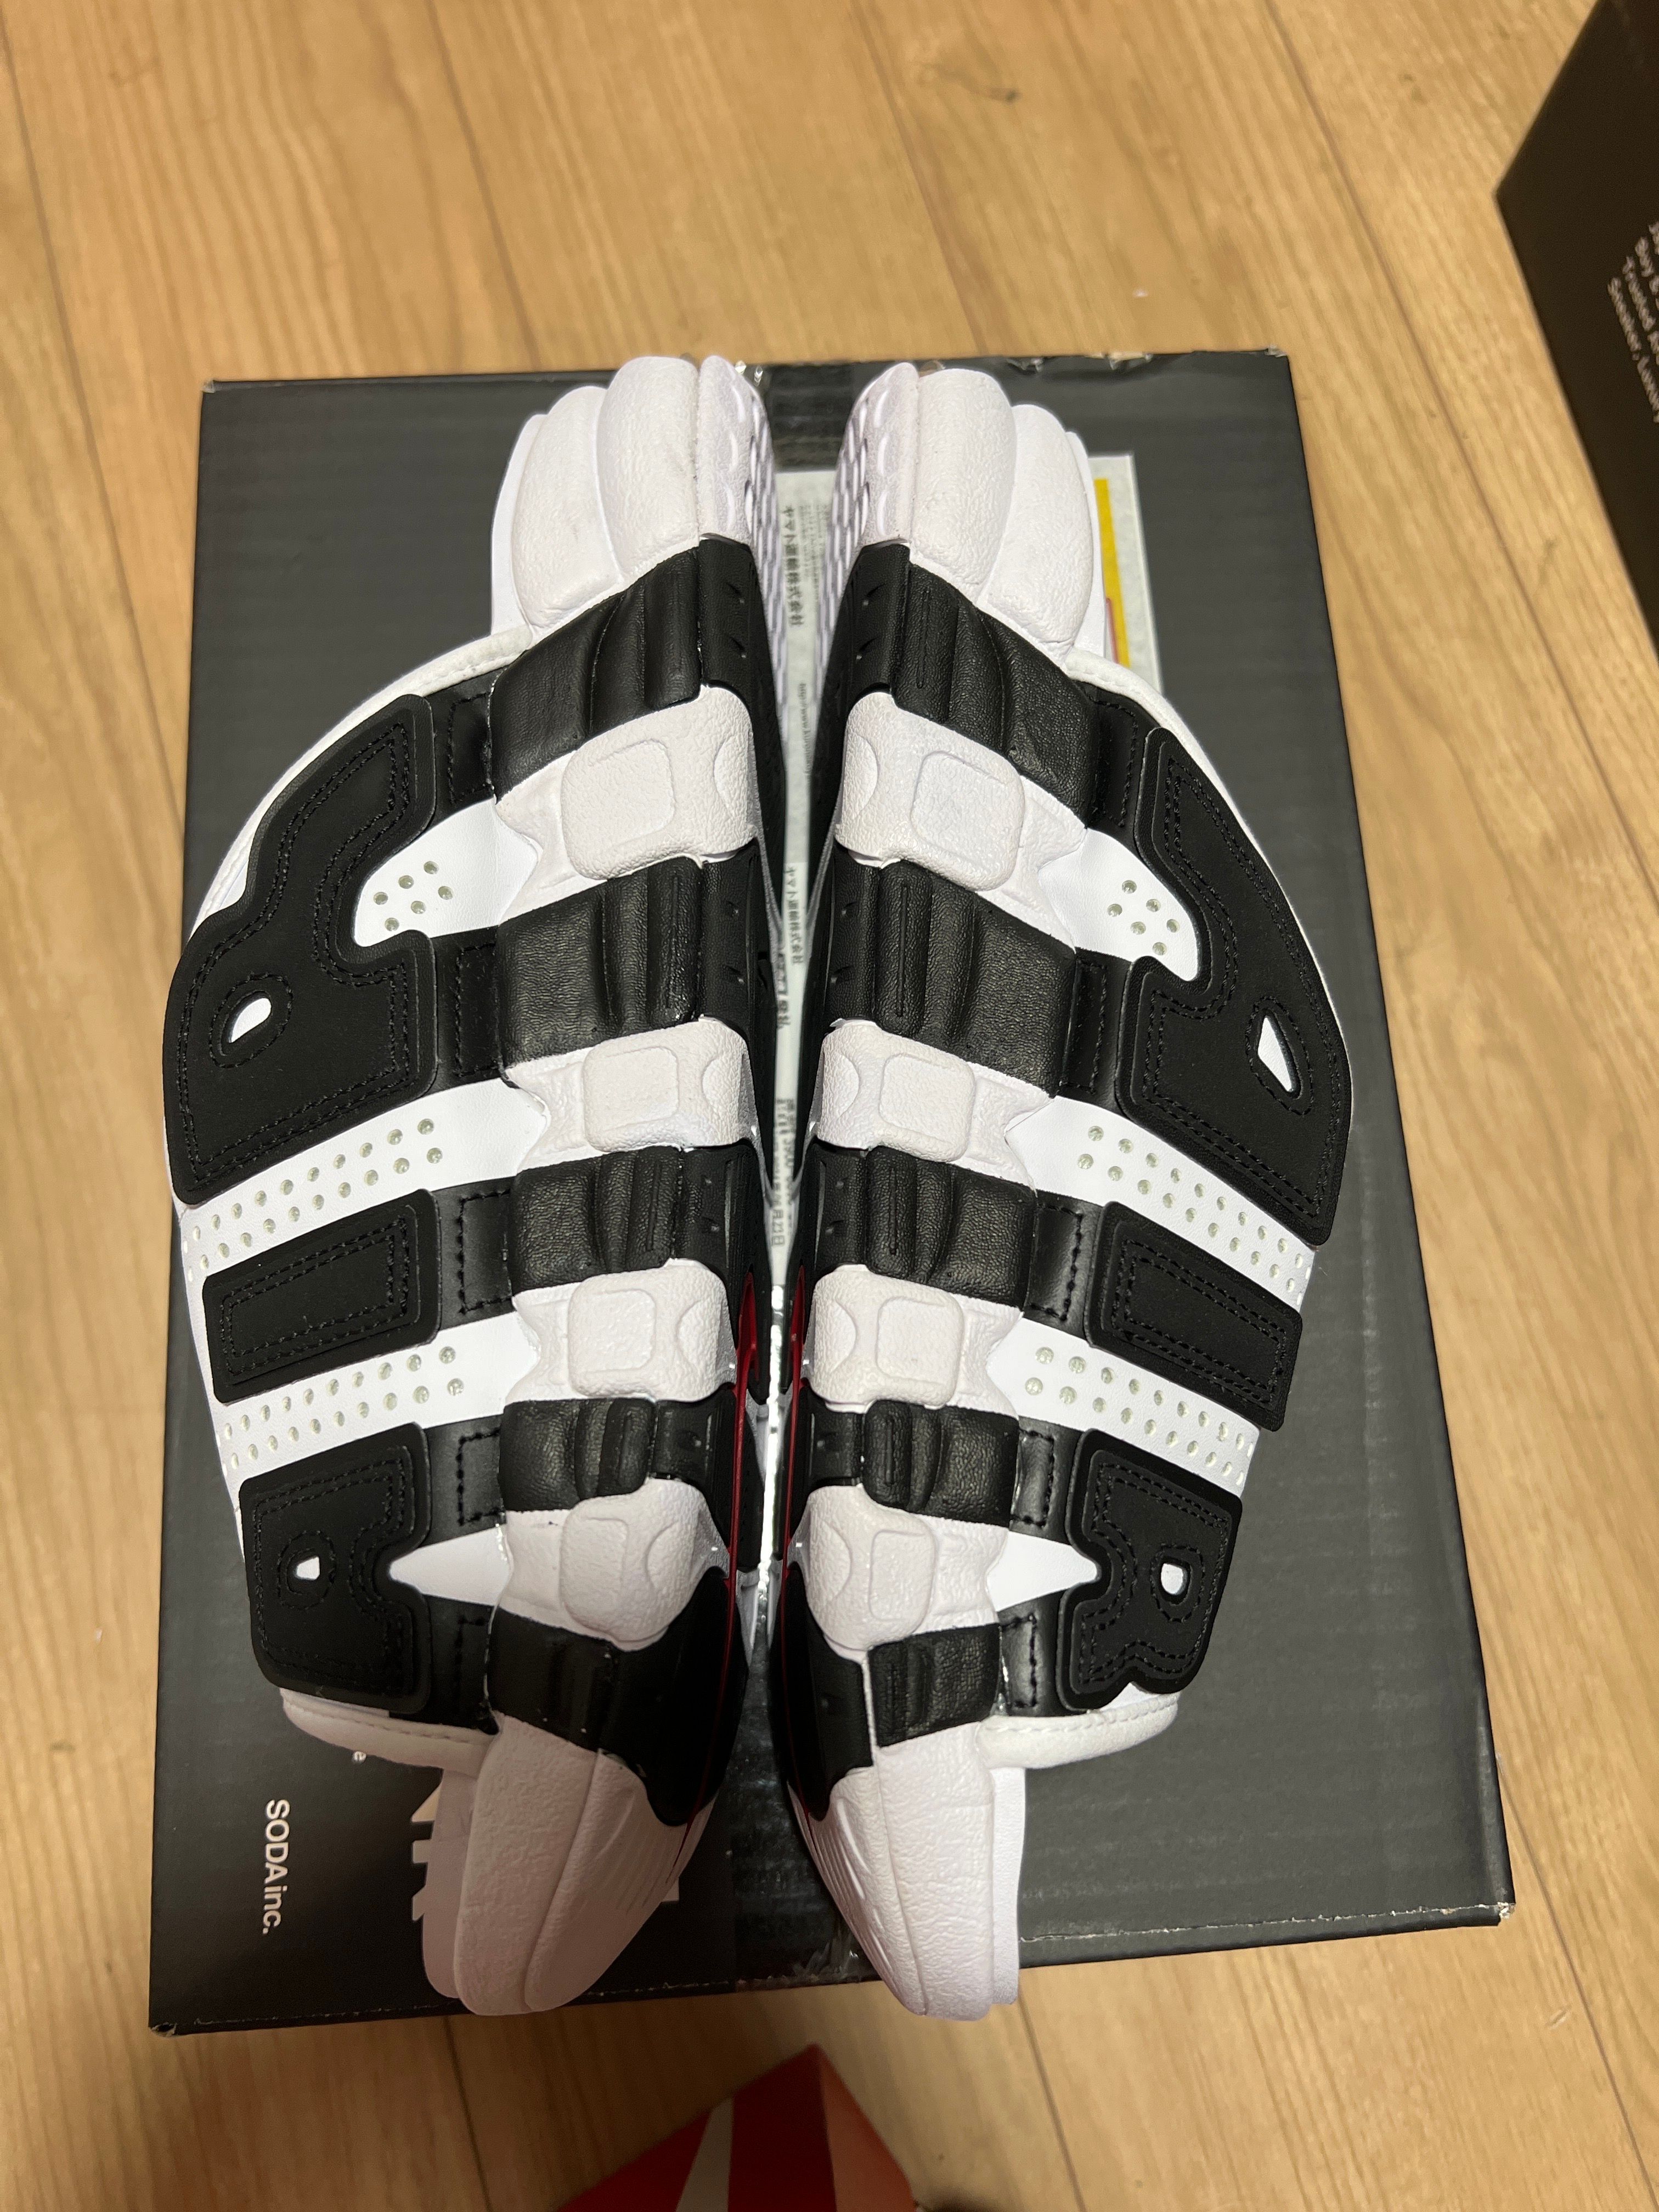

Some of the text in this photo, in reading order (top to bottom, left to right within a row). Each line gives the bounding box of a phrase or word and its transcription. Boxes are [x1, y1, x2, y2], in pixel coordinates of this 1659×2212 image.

[784, 866, 804, 964] ヤマト運輸株式会社
